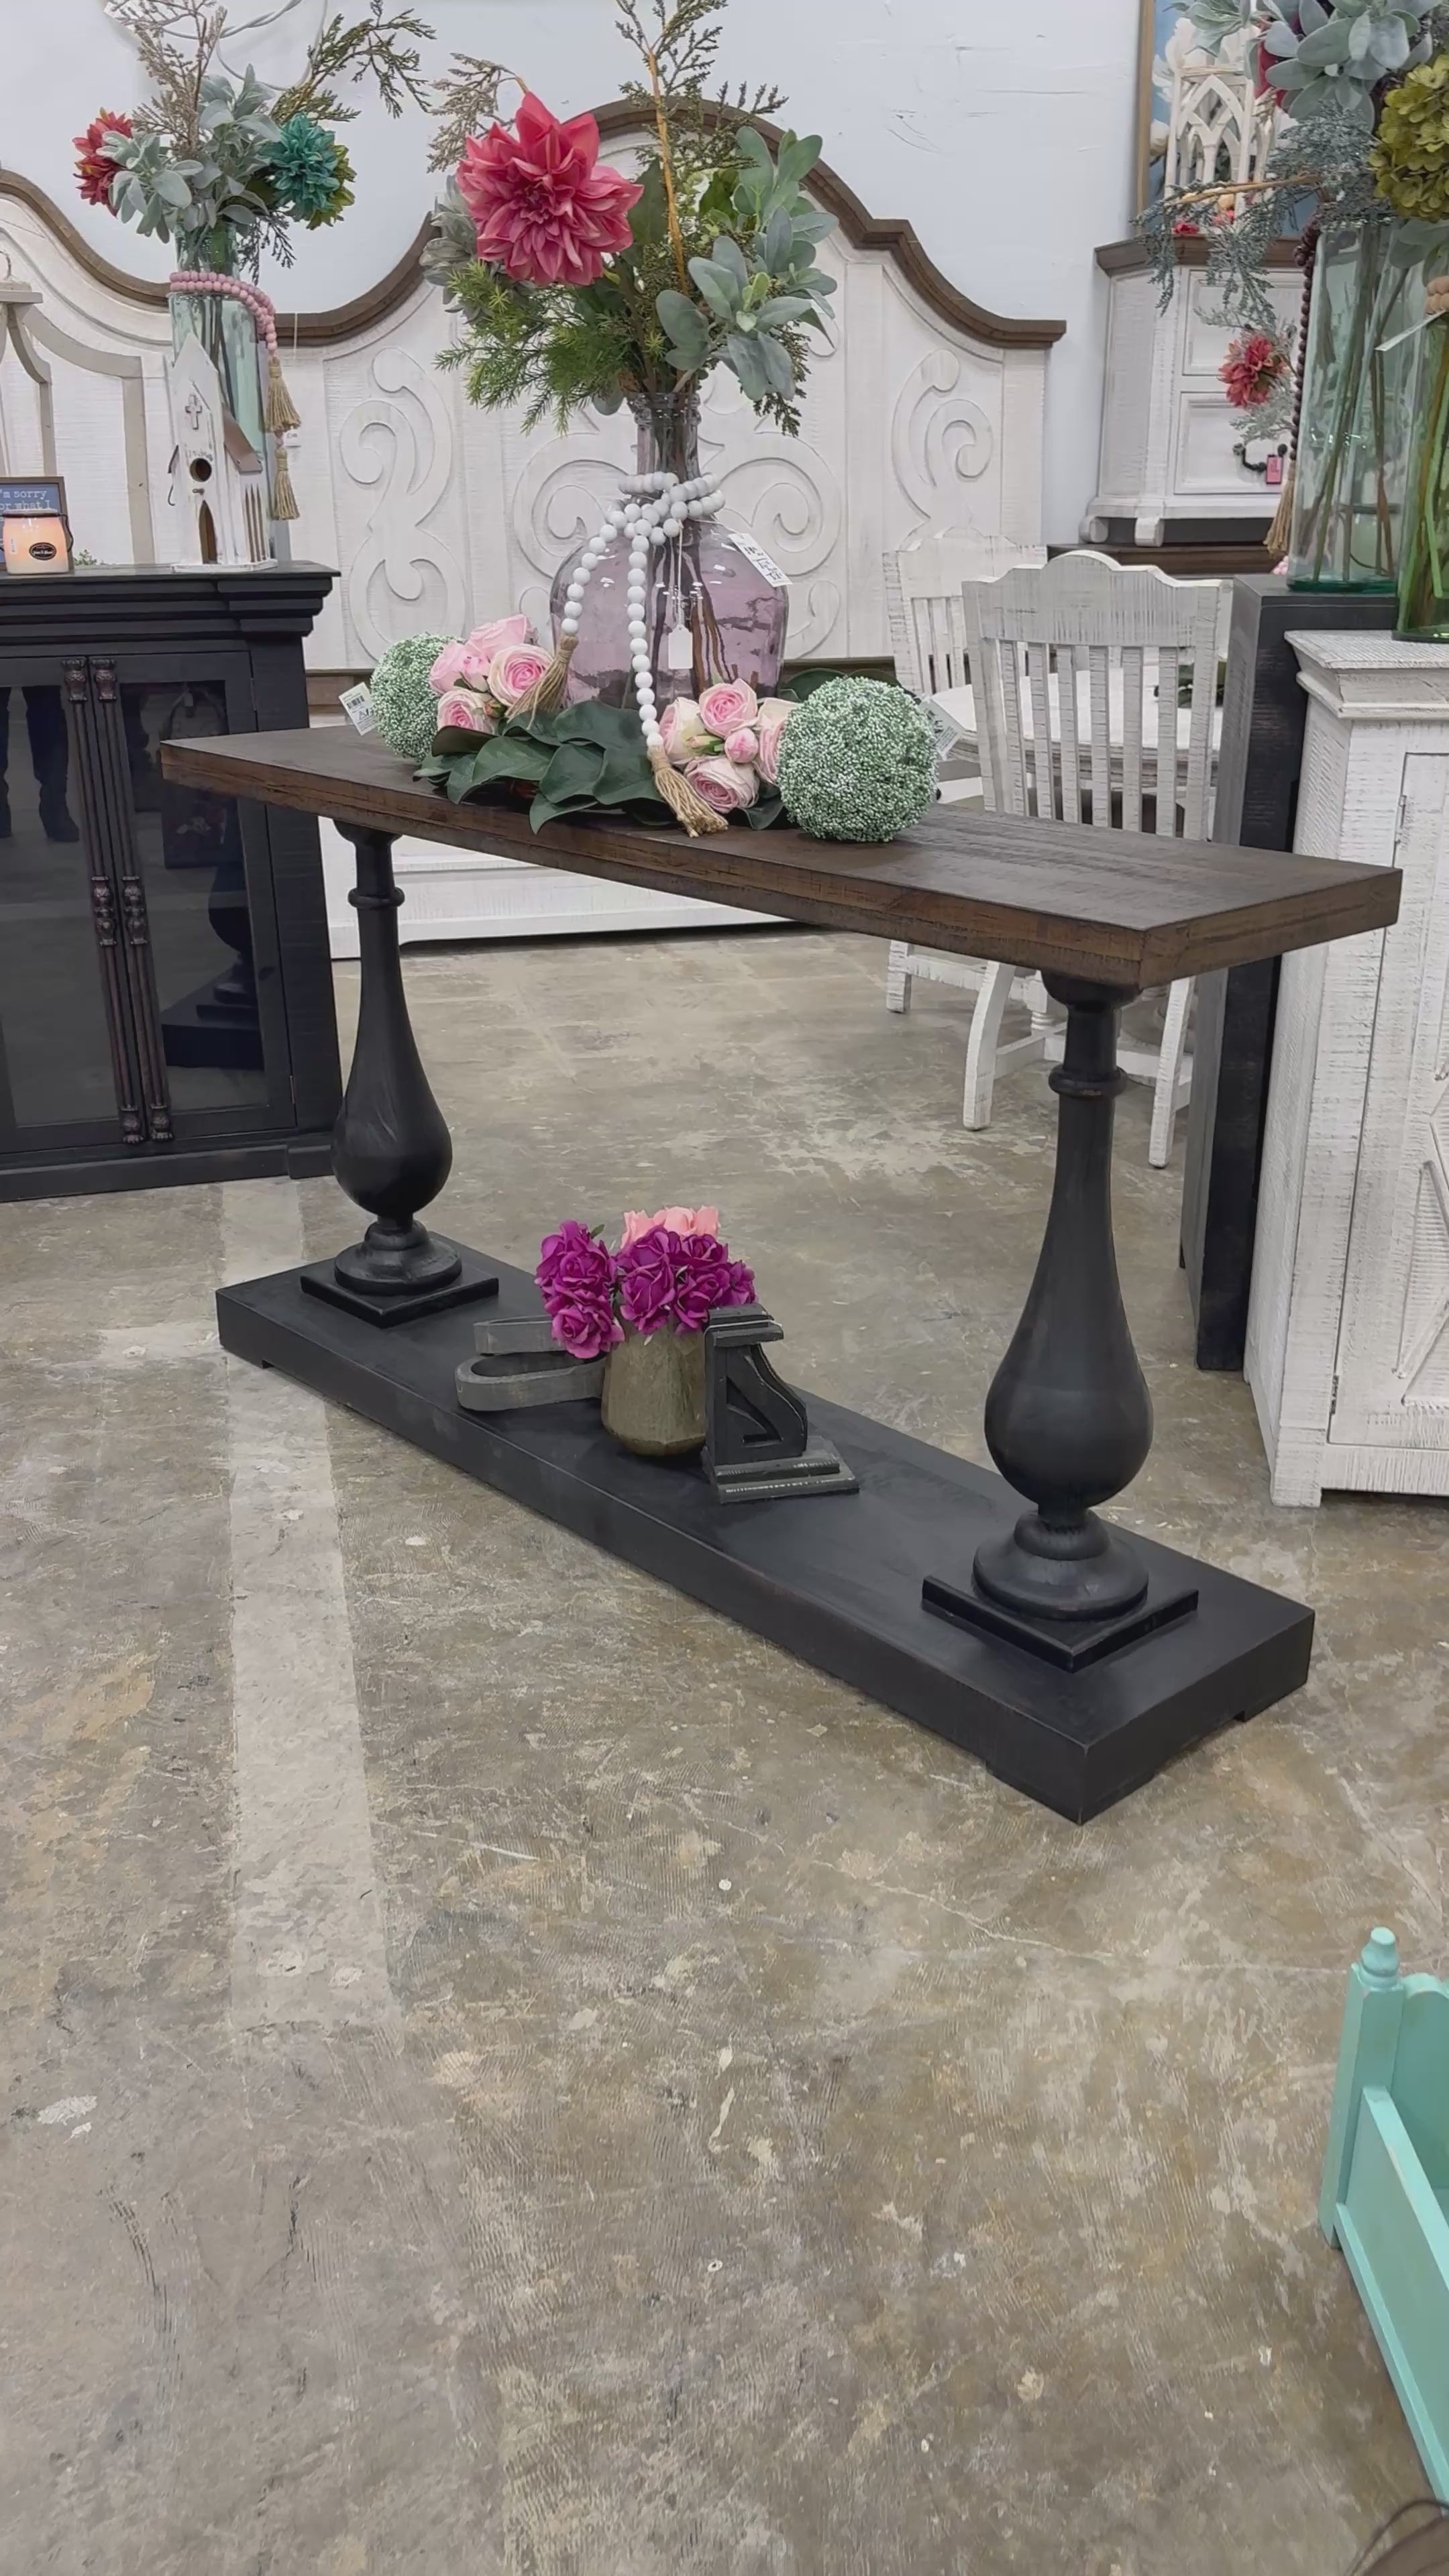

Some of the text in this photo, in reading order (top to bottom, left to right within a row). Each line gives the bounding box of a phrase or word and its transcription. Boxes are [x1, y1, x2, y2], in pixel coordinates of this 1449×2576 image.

[0, 489, 47, 500] 'm sorry
[15, 500, 43, 510] what
[44, 500, 51, 510] I
